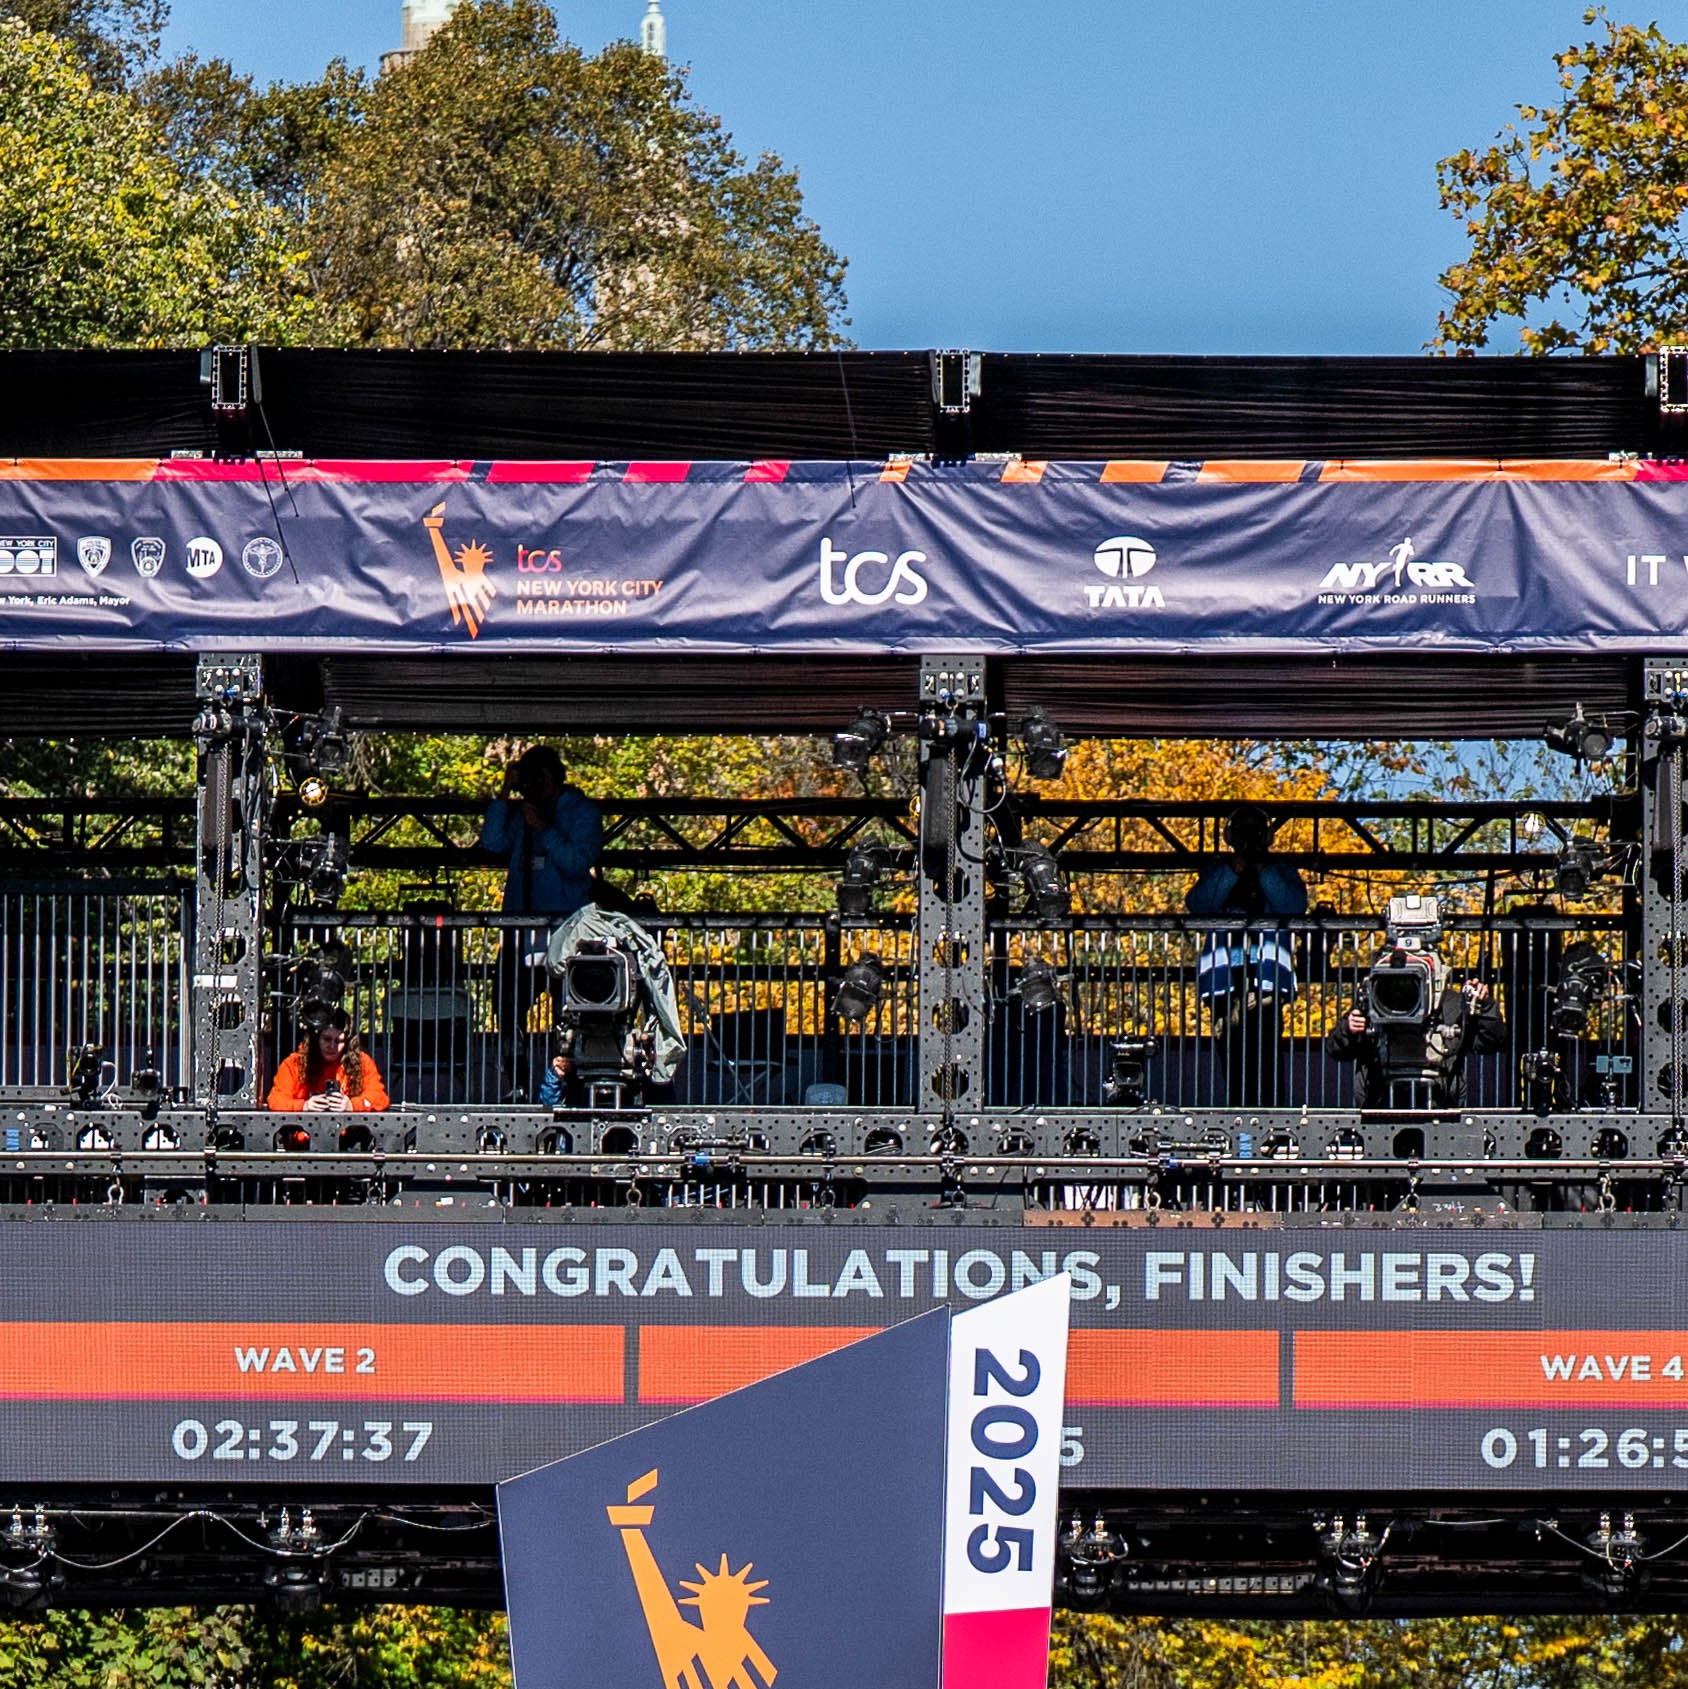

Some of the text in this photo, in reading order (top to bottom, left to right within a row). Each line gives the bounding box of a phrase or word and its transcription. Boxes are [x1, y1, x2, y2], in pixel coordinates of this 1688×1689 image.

[186, 547, 216, 570] MTA
[516, 543, 563, 573] tcs
[819, 536, 929, 606] tcs
[1625, 554, 1666, 587] IT
[7, 595, 35, 607] York,
[36, 595, 57, 605] Eric
[58, 595, 98, 607] Adams,
[99, 596, 131, 607] Mayor
[516, 580, 664, 597] NEW YORK CITY
[1082, 584, 1167, 608] TATA
[1317, 594, 1477, 605] NEW YORK ROAD RUNNERS
[516, 600, 627, 616] MARATHON
[383, 1244, 1536, 1309] CONGRATULATIONS, FINISHERS!
[234, 1347, 376, 1374] WAVE 2
[1539, 1354, 1684, 1382] WAVE 4
[172, 1420, 434, 1461] 02:37:37
[970, 1347, 1042, 1574] 2025
